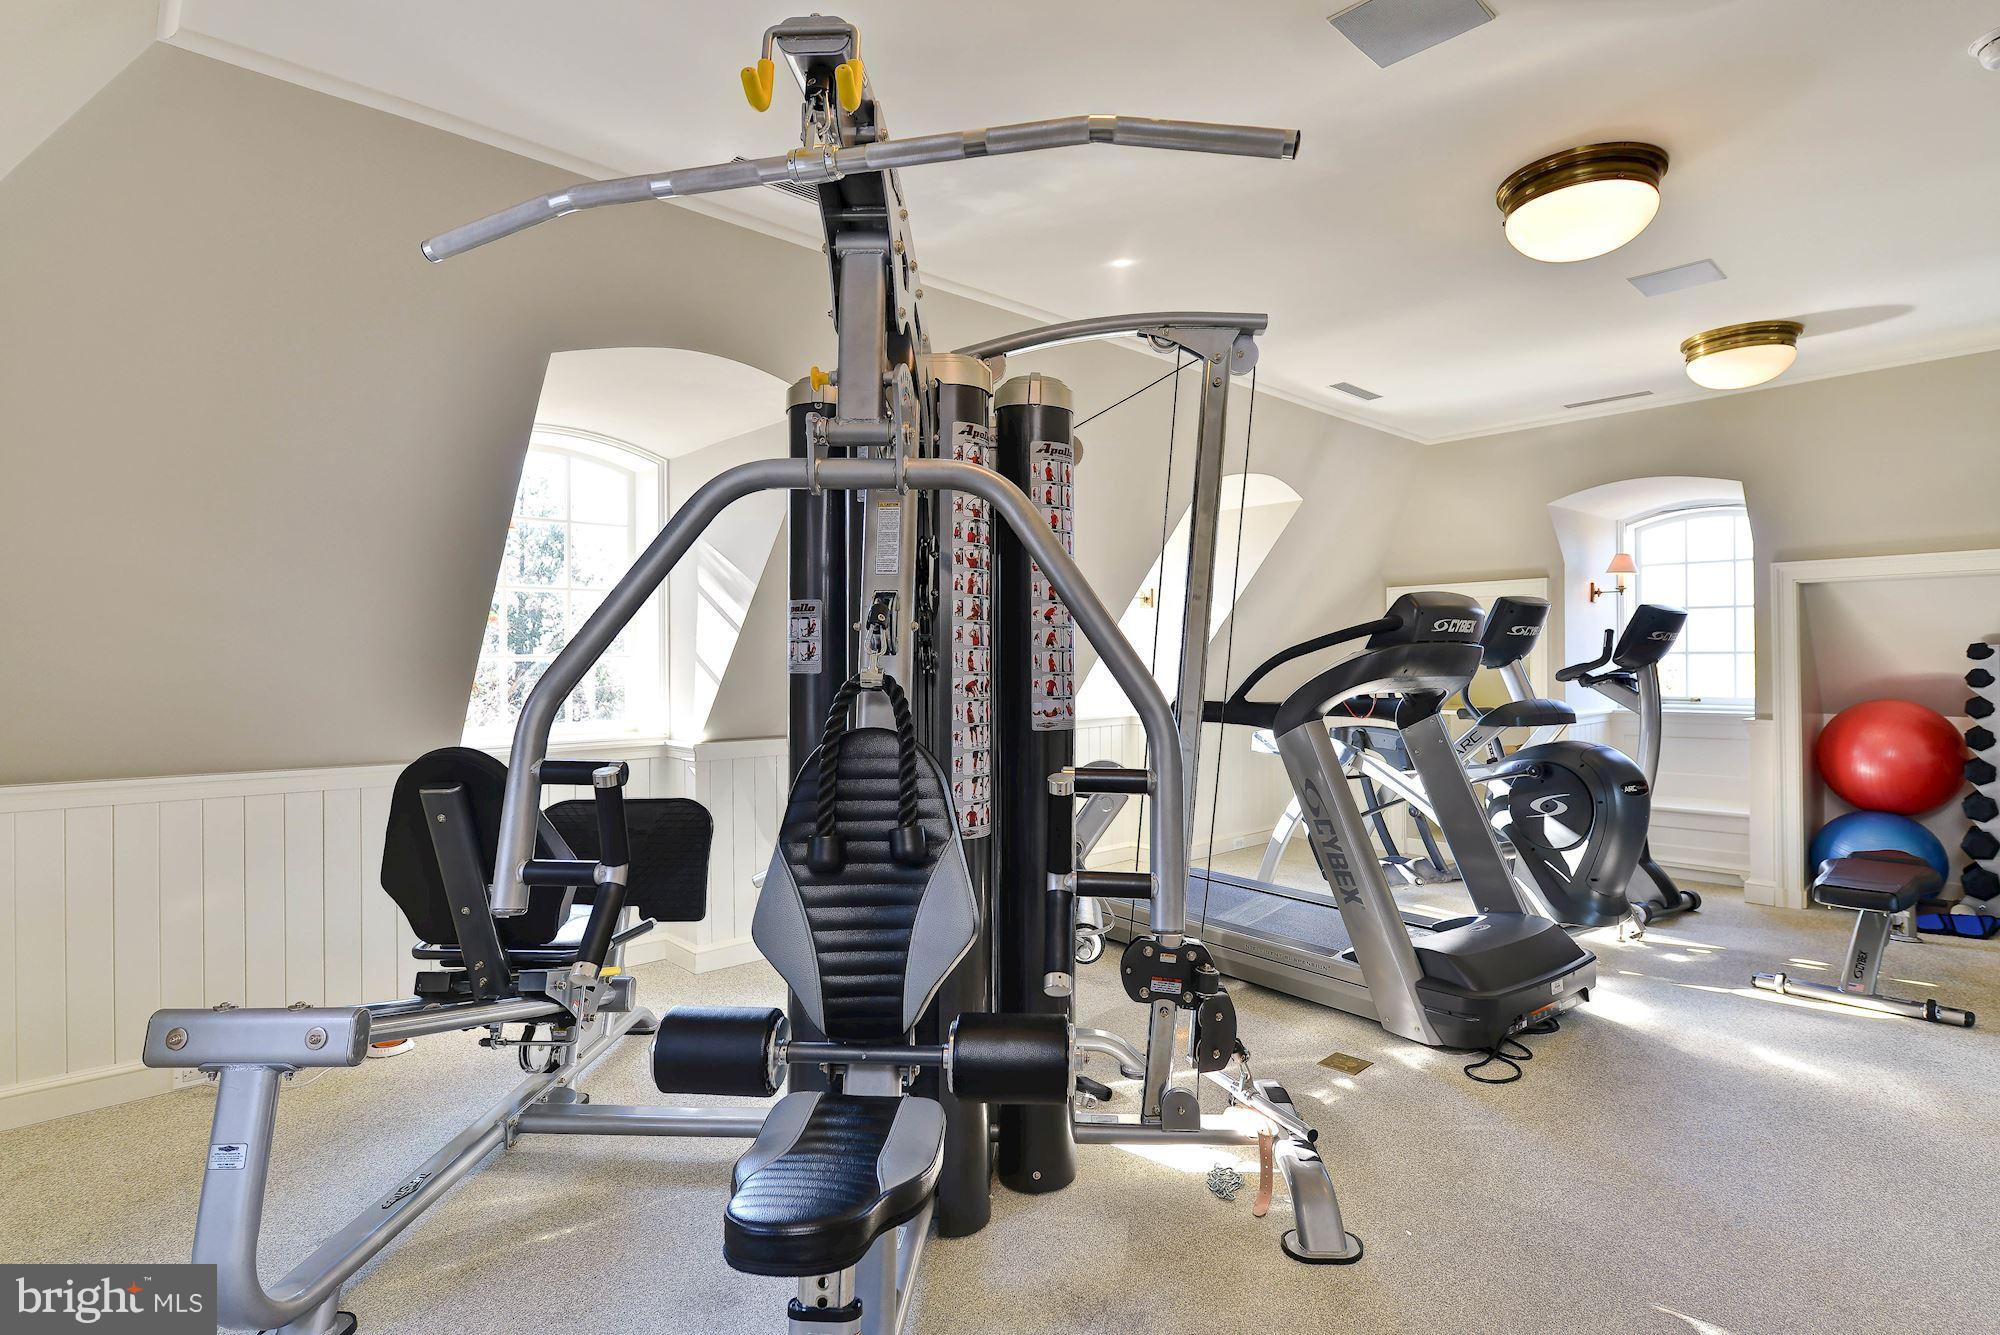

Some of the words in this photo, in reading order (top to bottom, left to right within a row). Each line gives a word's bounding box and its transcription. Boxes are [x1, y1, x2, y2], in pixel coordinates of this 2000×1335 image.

[958, 424, 989, 441] Apoll
[1447, 619, 1477, 633] CYBEX
[1313, 819, 1364, 909] CYBEX
